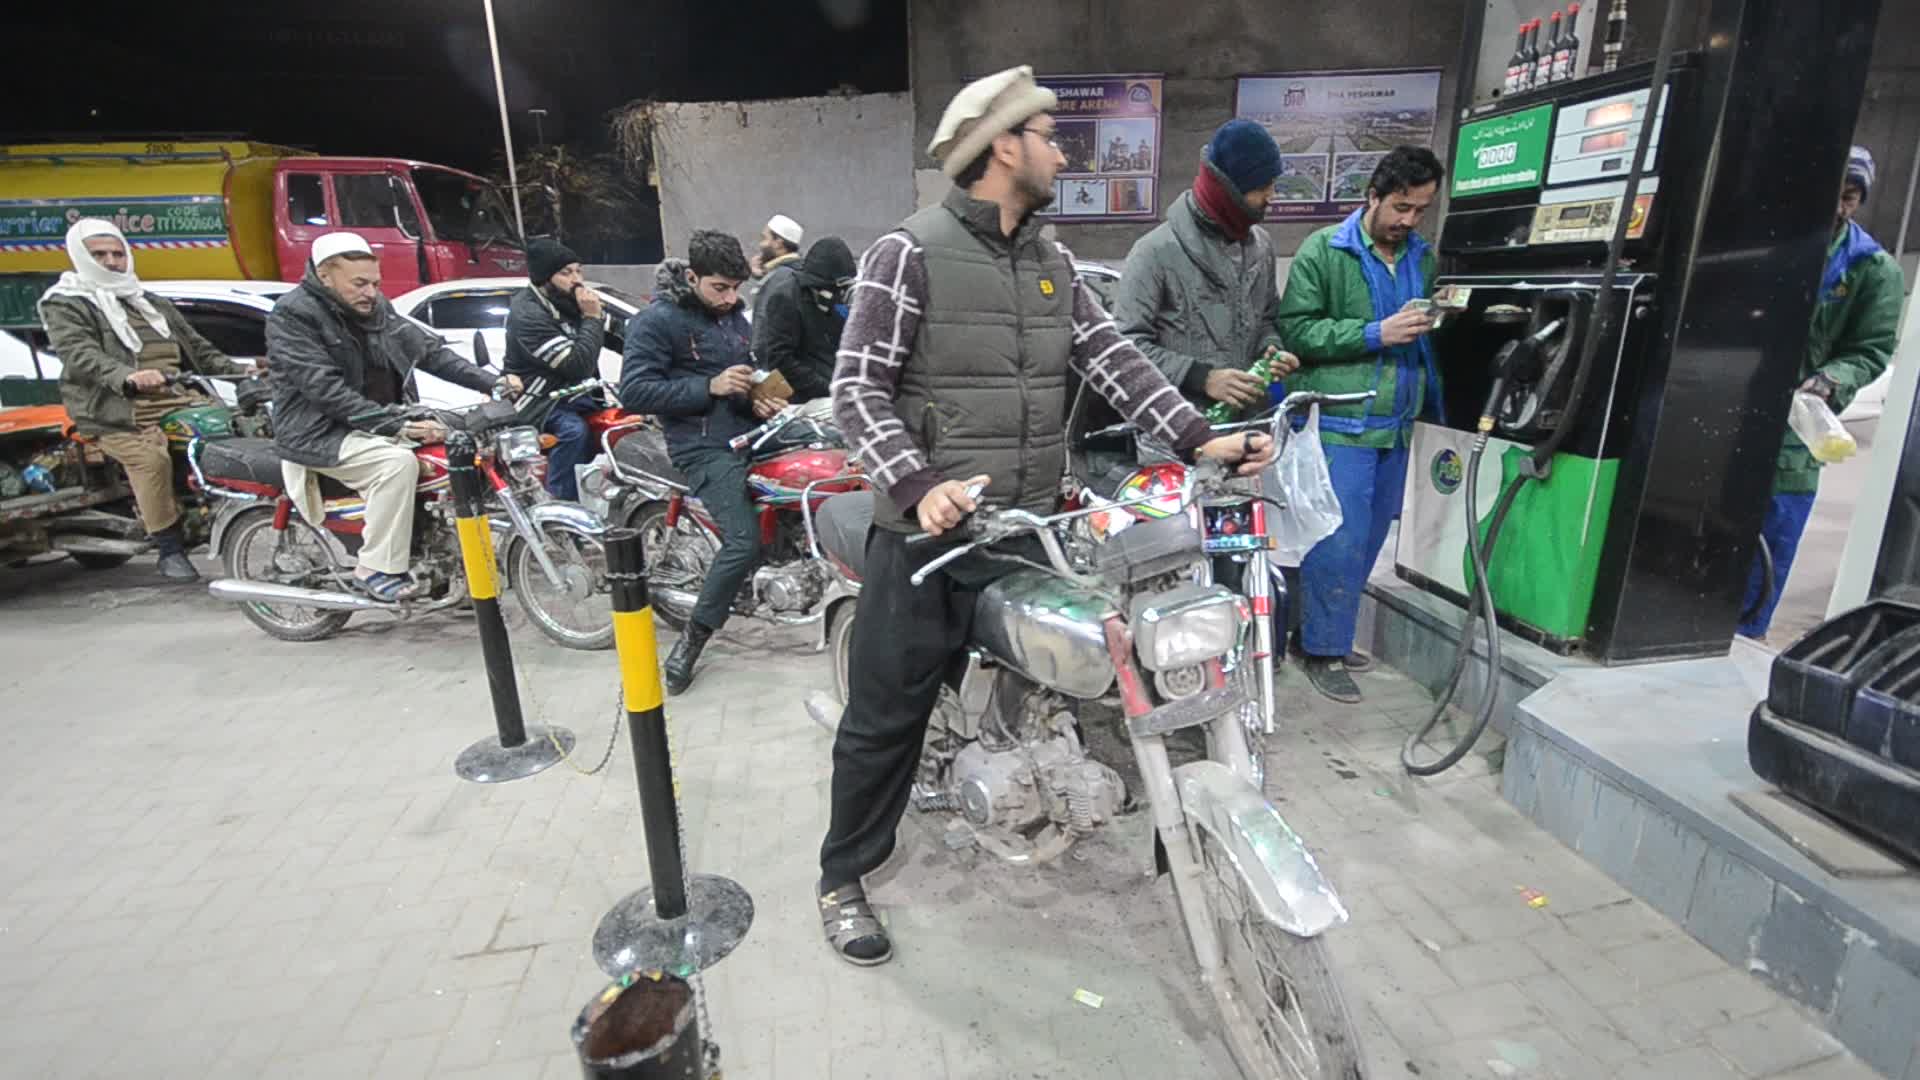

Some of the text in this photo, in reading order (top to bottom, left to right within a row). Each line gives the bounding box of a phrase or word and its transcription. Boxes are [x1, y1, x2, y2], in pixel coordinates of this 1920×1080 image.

[1055, 87, 1104, 98] ESHAWAR
[0, 207, 154, 233] rrier Svice
